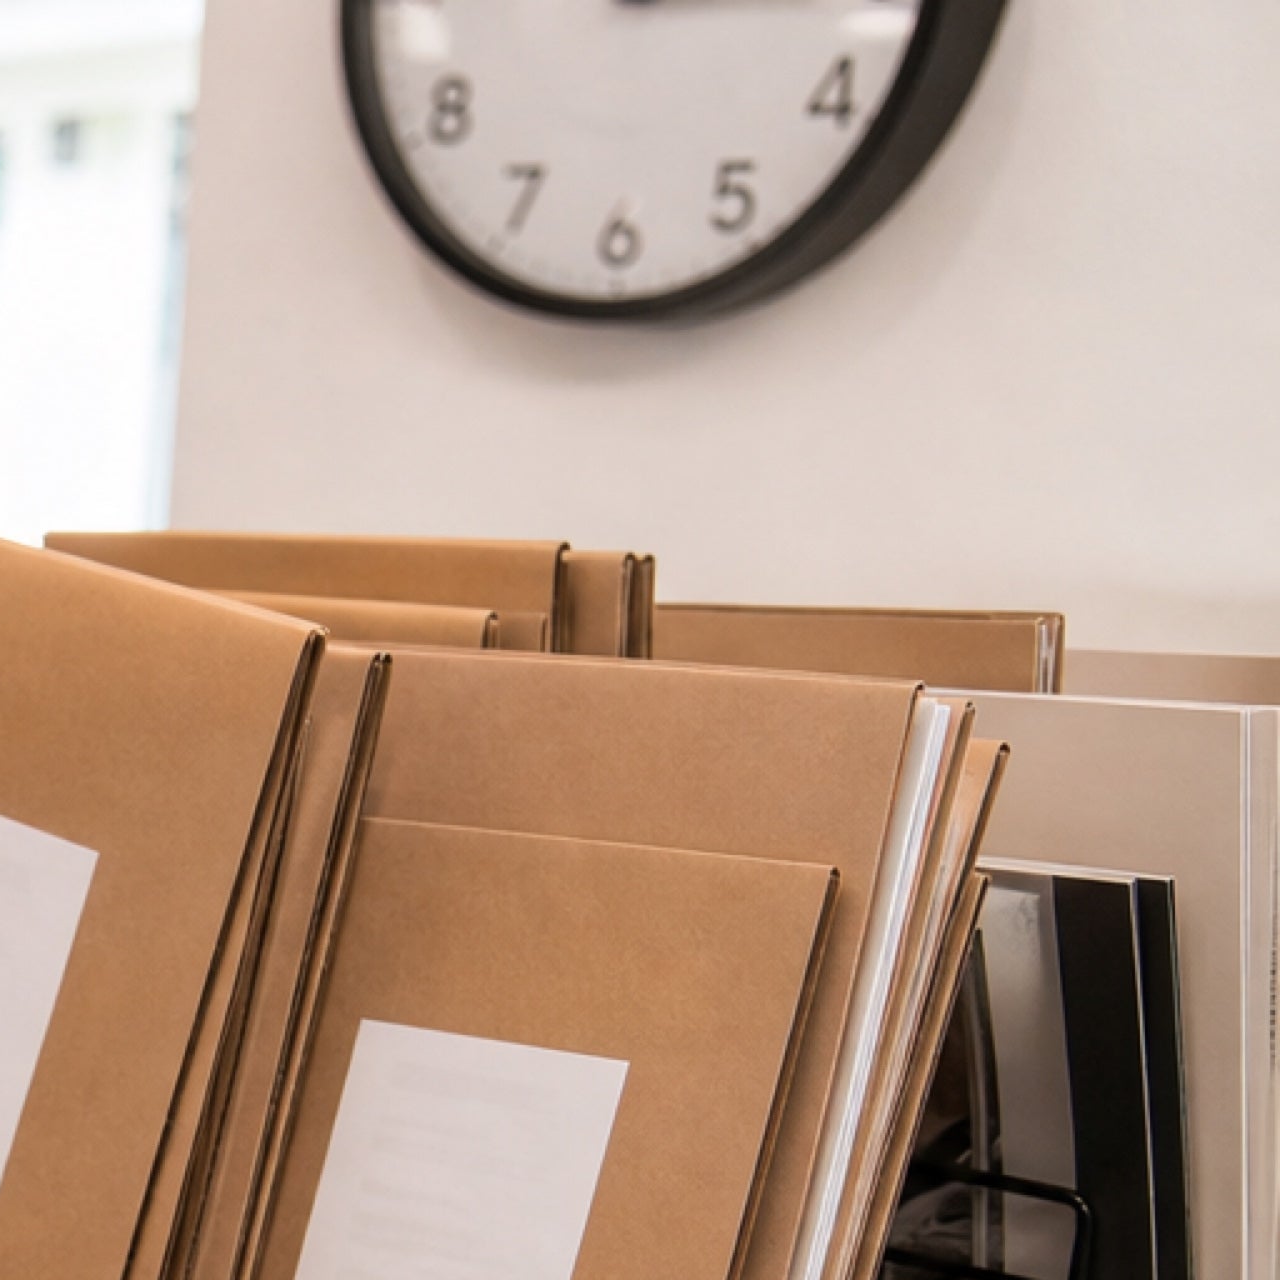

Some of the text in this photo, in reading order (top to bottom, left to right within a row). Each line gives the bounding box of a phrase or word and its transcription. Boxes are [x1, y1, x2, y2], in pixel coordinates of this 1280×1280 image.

[428, 73, 471, 146] 8
[804, 53, 856, 129] 4
[503, 162, 547, 233] 7
[709, 159, 756, 232] 5
[596, 200, 643, 268] 6
